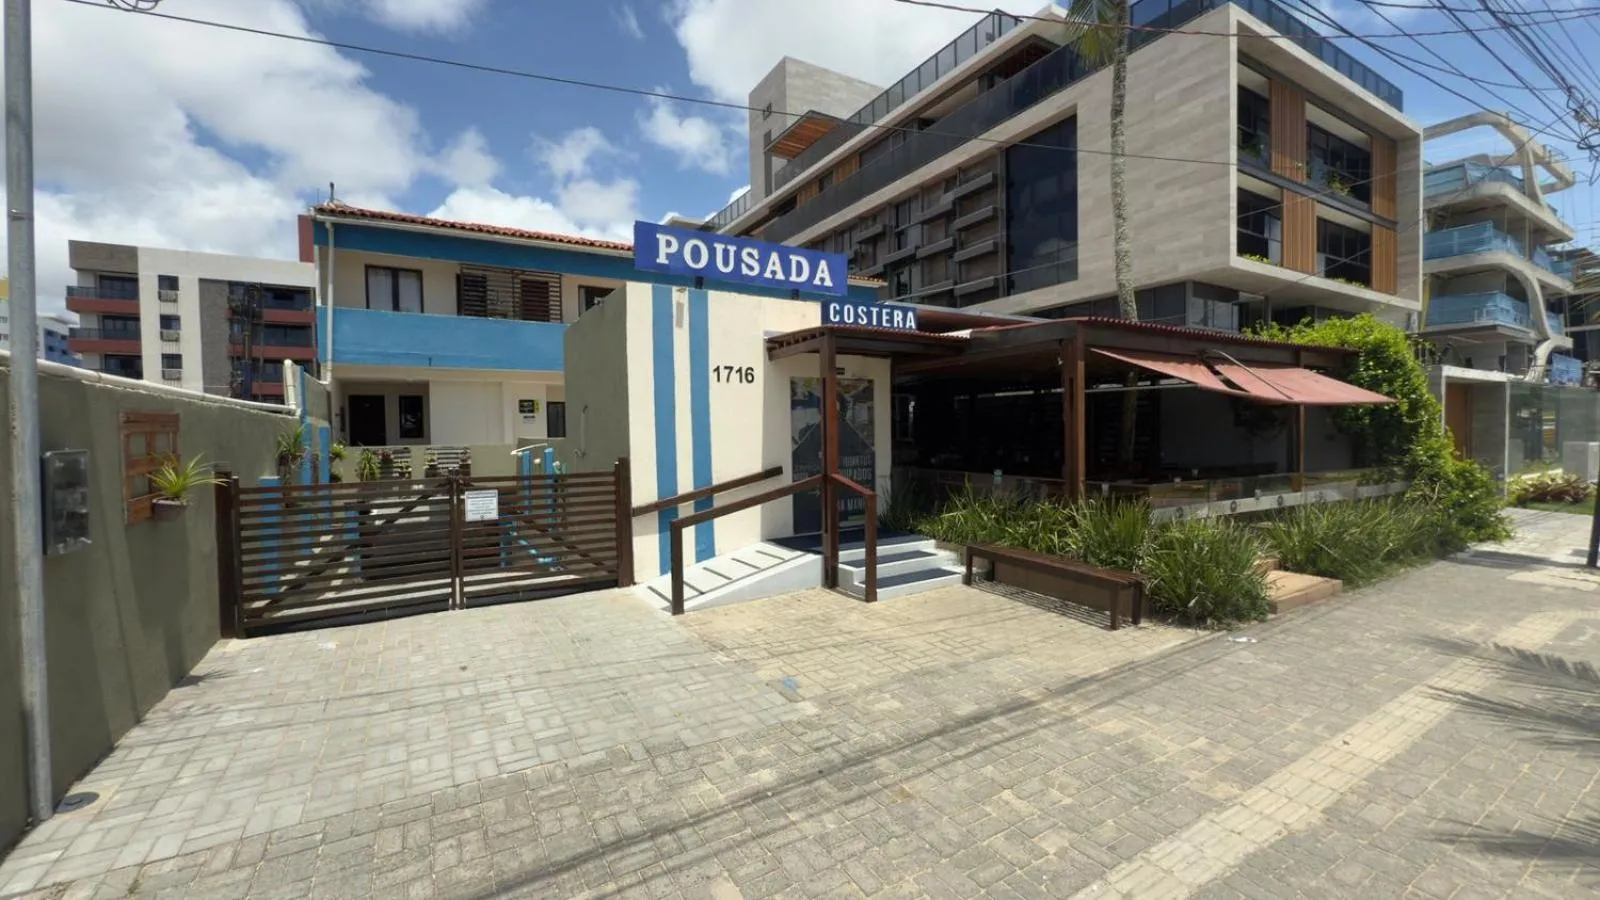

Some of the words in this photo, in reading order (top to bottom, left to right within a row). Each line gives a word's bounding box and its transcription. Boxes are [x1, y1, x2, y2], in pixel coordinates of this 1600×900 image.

[656, 233, 833, 287] POUSADA
[829, 302, 916, 329] COSTERA
[713, 365, 755, 384] 1716
